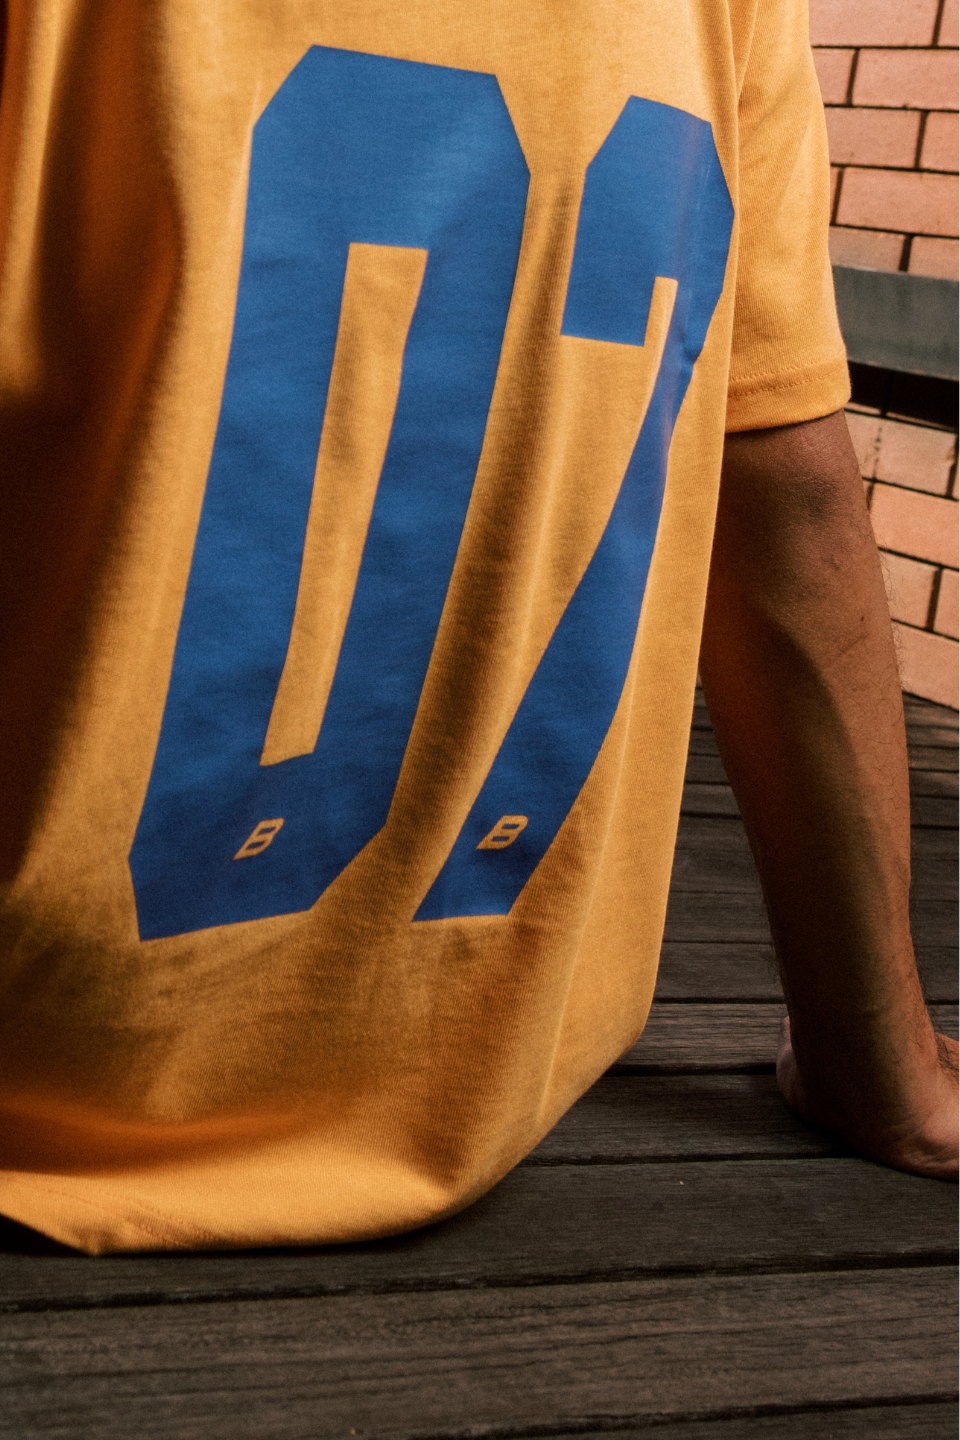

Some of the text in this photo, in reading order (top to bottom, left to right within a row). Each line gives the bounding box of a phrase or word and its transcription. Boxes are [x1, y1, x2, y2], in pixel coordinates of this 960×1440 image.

[128, 44, 735, 941] 07
[233, 817, 284, 860] B
[476, 814, 528, 850] B
